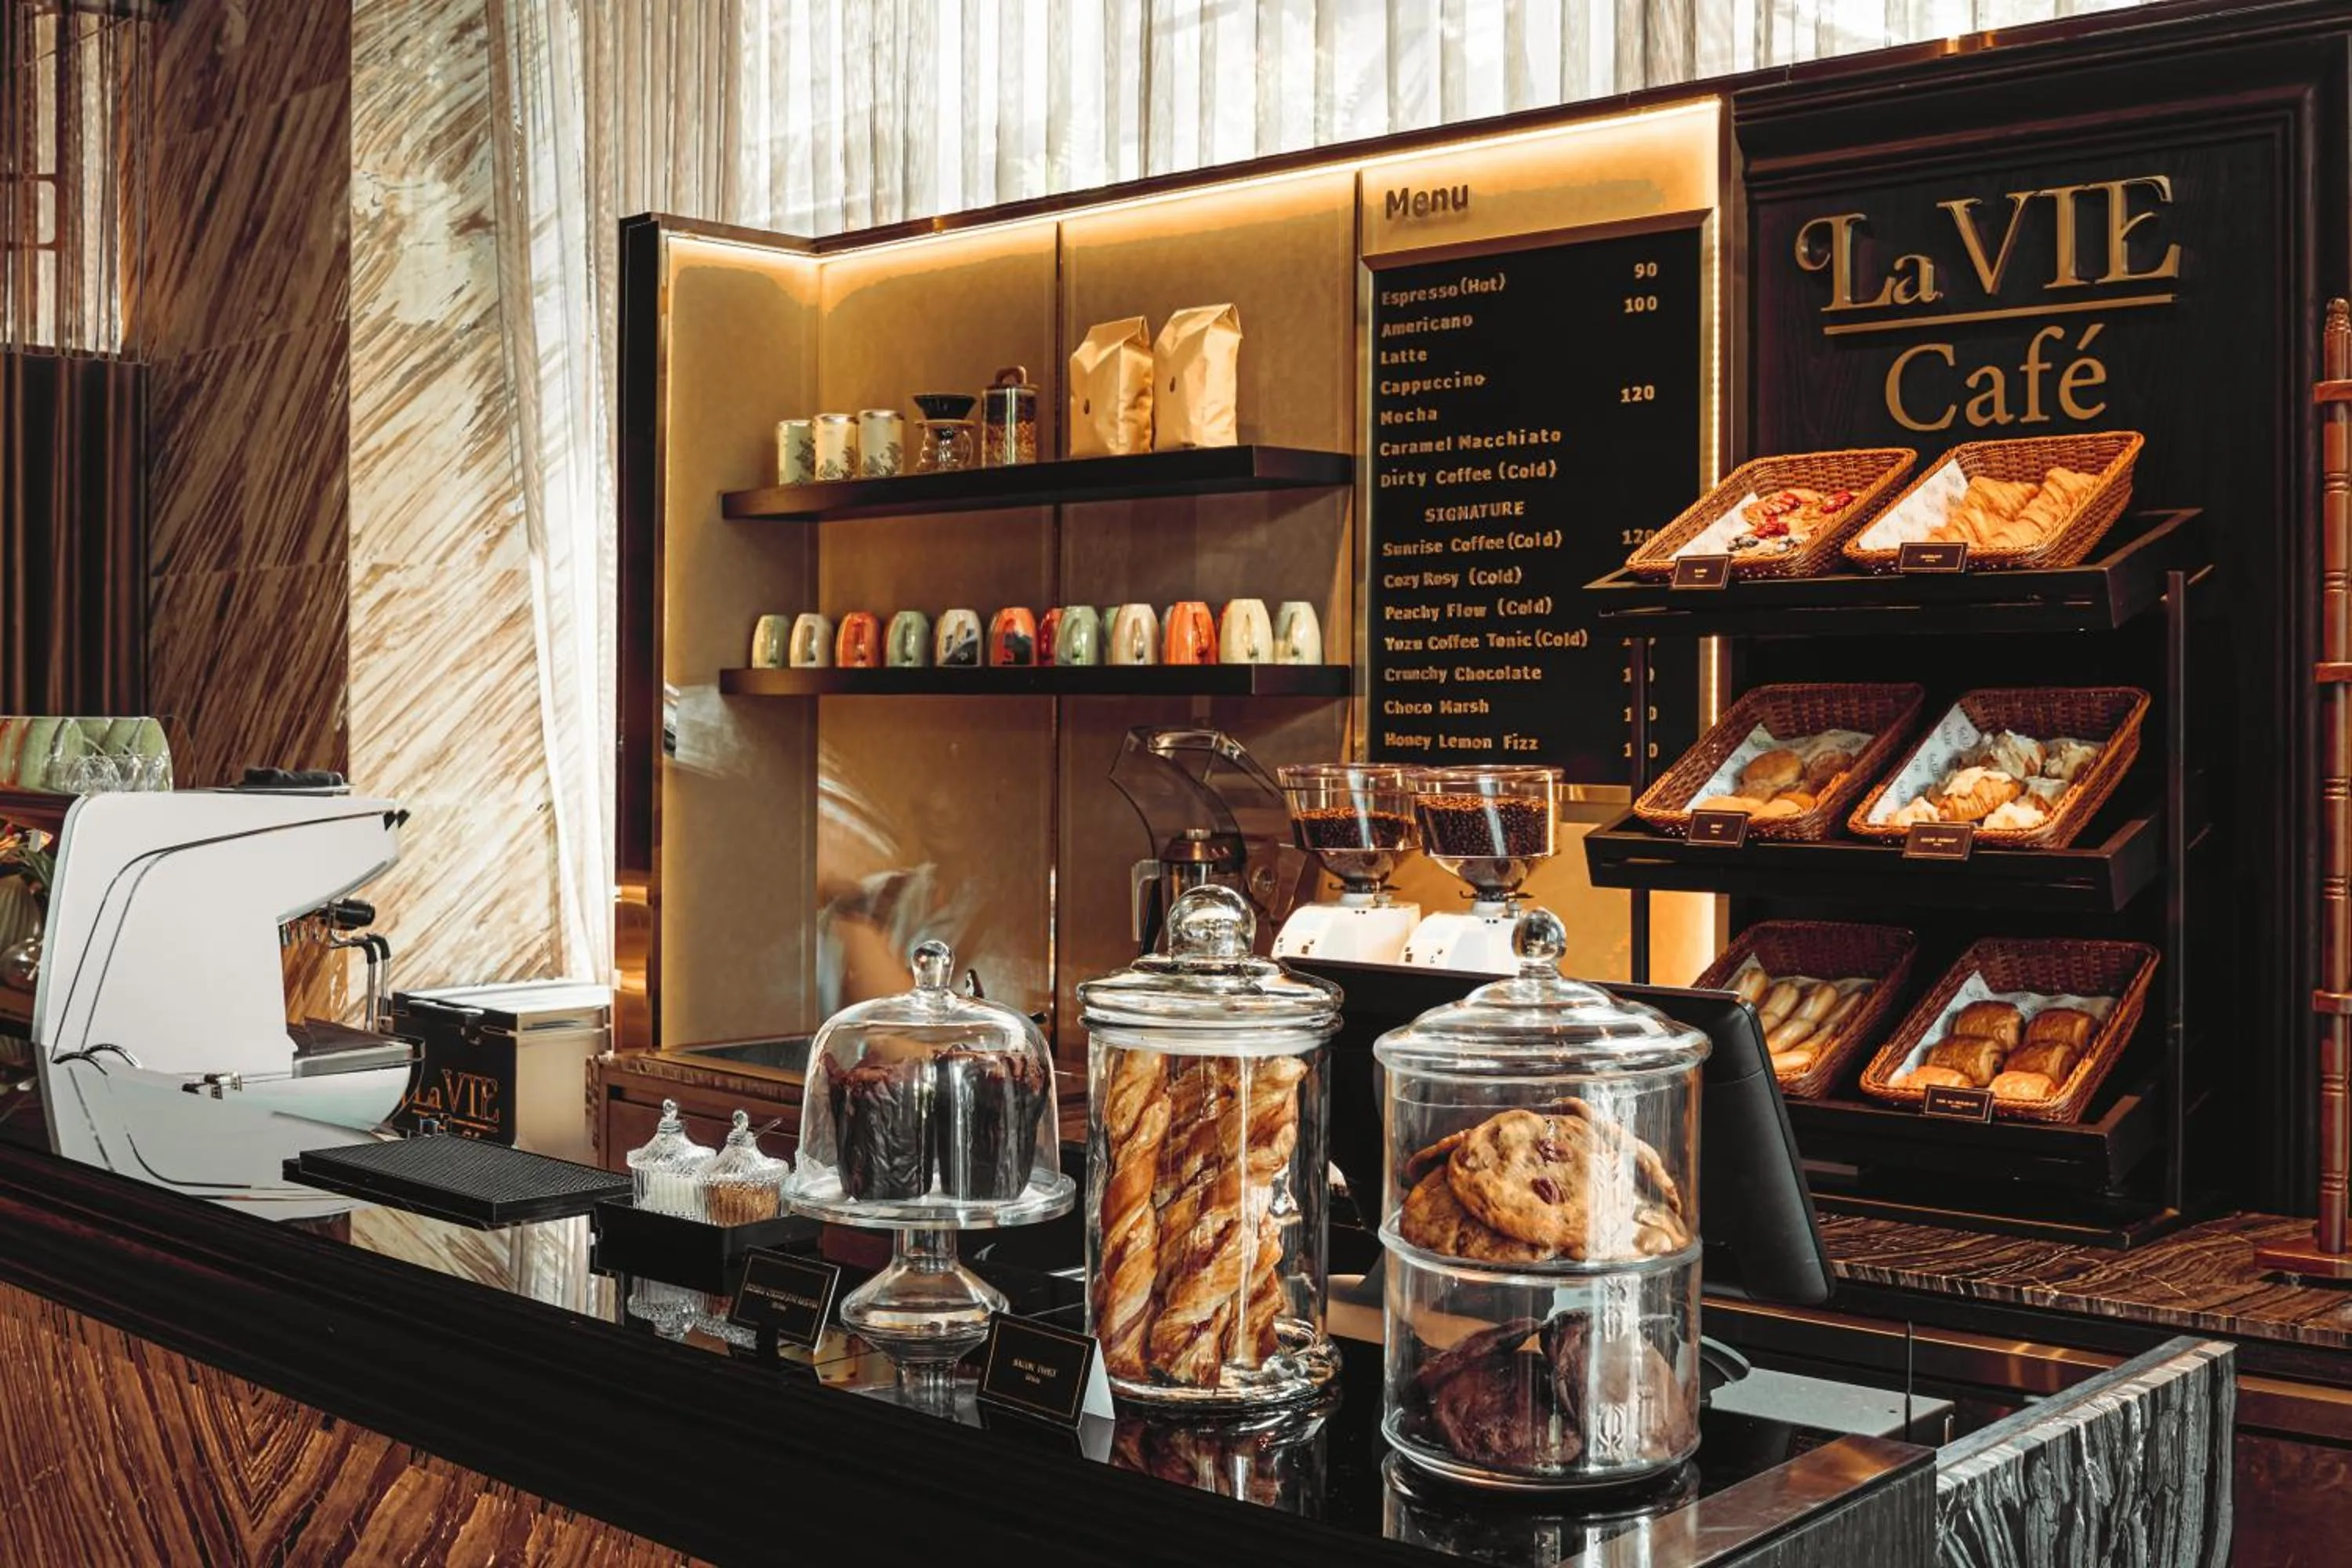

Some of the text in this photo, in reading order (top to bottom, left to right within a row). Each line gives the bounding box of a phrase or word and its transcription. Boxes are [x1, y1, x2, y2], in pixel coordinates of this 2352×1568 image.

[1385, 184, 1468, 220] Menu
[1635, 263, 1657, 278] 90
[1624, 296, 1657, 313] 100
[1382, 315, 1472, 337] Americano
[1381, 350, 1427, 364] Latte
[1381, 372, 1485, 395] Cappuccino
[1885, 323, 2107, 432] Café
[1621, 385, 1654, 402] 120
[1381, 408, 1437, 425] Mocha
[1380, 430, 1561, 456] Caramel Macchiato
[1381, 459, 1556, 487] Dirty Coffee (Cold)
[1425, 502, 1524, 522] SIGNATURE
[1383, 539, 1443, 556] Sunrise
[1385, 566, 1522, 588] Cozy Rosy (Cold)
[1385, 597, 1552, 621] Peachy Flow (Cold)
[1428, 634, 1479, 650] Coffee
[1385, 666, 1541, 683] Crunchy Chocolate
[1385, 699, 1489, 714] Choco Marsh
[1624, 706, 1657, 721] 10
[1385, 732, 1538, 750] Honey Lemon Fizz
[1624, 743, 1658, 757] 10
